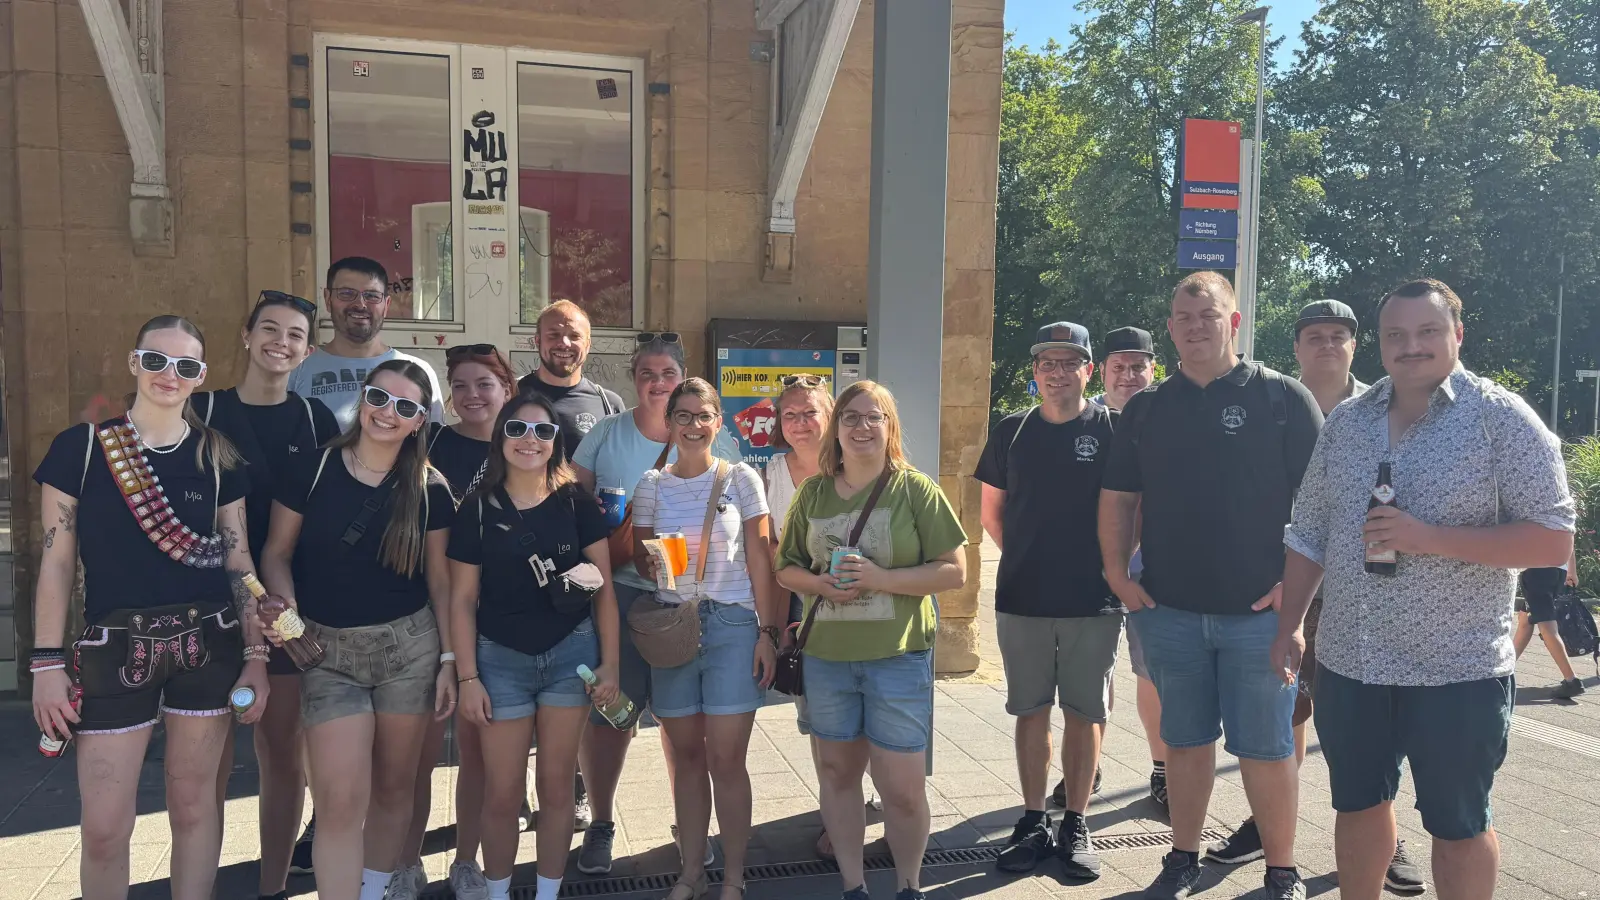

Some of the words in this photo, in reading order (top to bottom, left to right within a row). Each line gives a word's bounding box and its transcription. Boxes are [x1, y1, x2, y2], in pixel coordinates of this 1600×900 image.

[354, 66, 369, 77] 94
[1189, 186, 1238, 196] Sulzbach-Rosenberg
[1195, 221, 1217, 229] Richtung
[1195, 228, 1218, 236] Nürnberg
[1192, 251, 1225, 262] Ausgang
[736, 373, 752, 382] HIER
[311, 382, 358, 397] REGISTERED
[743, 453, 769, 463] ahlen
[184, 490, 203, 502] Mia
[557, 543, 571, 555] Lea
